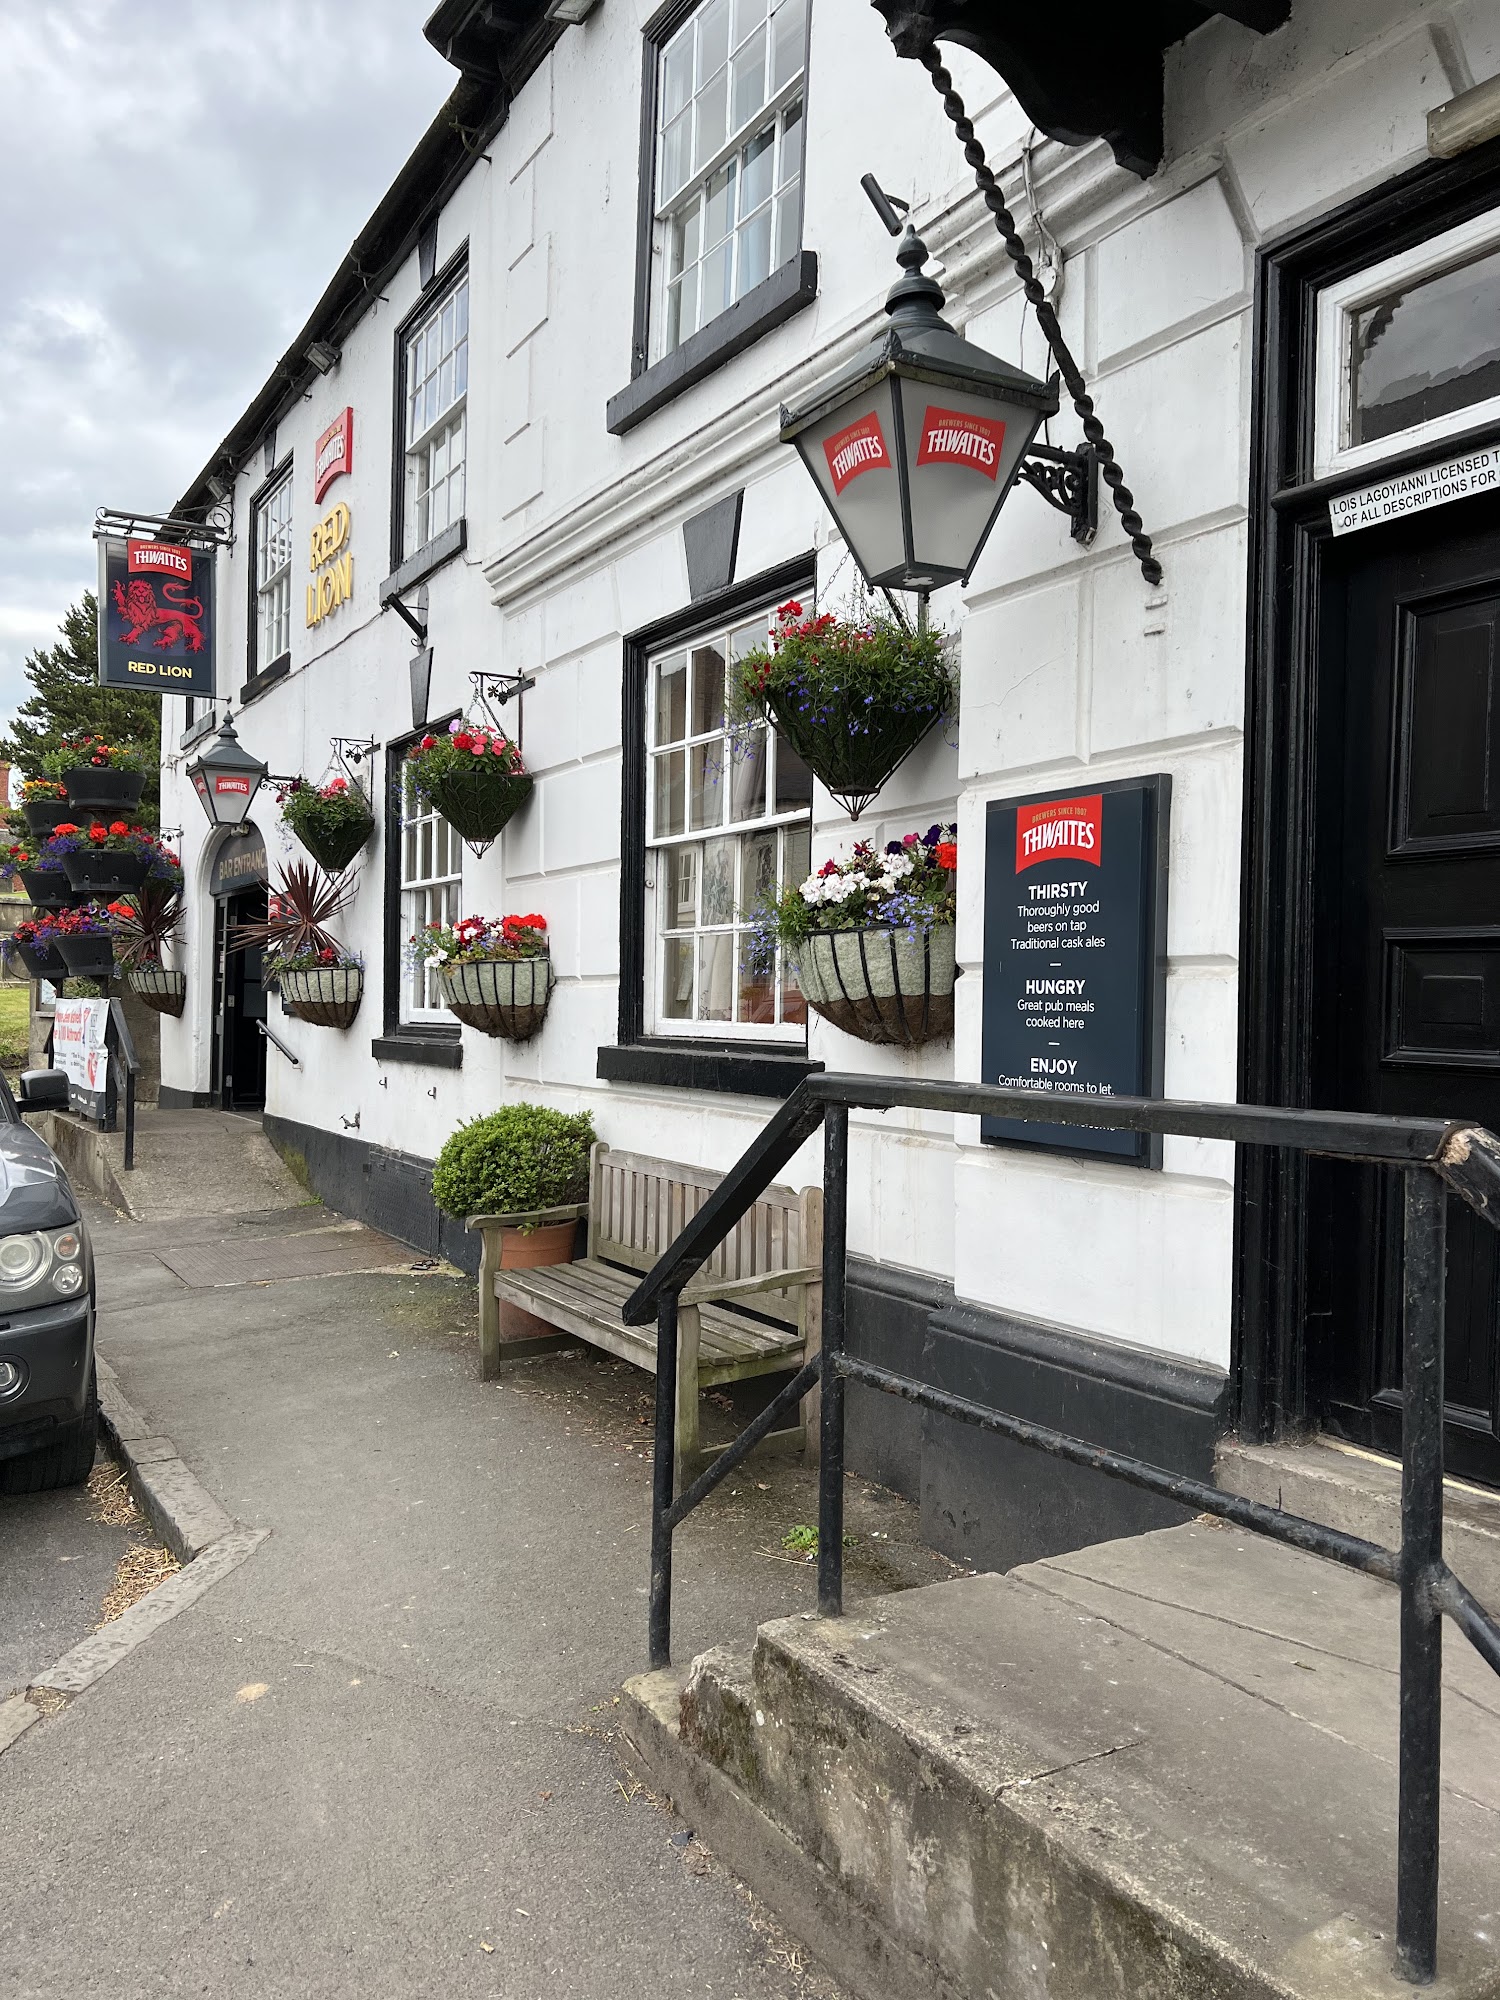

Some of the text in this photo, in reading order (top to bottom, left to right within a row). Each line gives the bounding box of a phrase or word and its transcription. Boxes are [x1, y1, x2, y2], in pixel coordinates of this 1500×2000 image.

[938, 419, 963, 428] BREWERS
[964, 421, 979, 432] SINCE
[927, 429, 996, 466] THWAITES
[832, 435, 883, 480] THWAITES
[1333, 498, 1356, 515] LOIS
[1360, 474, 1427, 506] LAGOYIANNI
[1430, 454, 1489, 484] LICENSED
[1344, 470, 1497, 527] OF ALL DESCRIPTIONS FOR
[310, 502, 351, 573] RED
[134, 551, 187, 571] THWAITES
[306, 552, 352, 629] LION
[128, 661, 192, 679] RED LION
[218, 781, 248, 792] THWAITES
[1032, 807, 1087, 823] BREWERS SINCE 1807
[1022, 819, 1094, 856] THWAITES
[220, 859, 233, 880] BAR
[1028, 881, 1088, 900] THIRSTY
[1017, 901, 1100, 917] Thoroughly good
[1028, 920, 1087, 933] beers on tap
[1011, 936, 1105, 950] Traditional cask ales
[1026, 979, 1085, 995] HUNGRY
[1017, 999, 1095, 1013] Great pub meals
[1026, 1016, 1084, 1029] cooked here
[1030, 1058, 1078, 1075] ENJOY
[999, 1074, 1115, 1095] Comfortable rooms to let.
